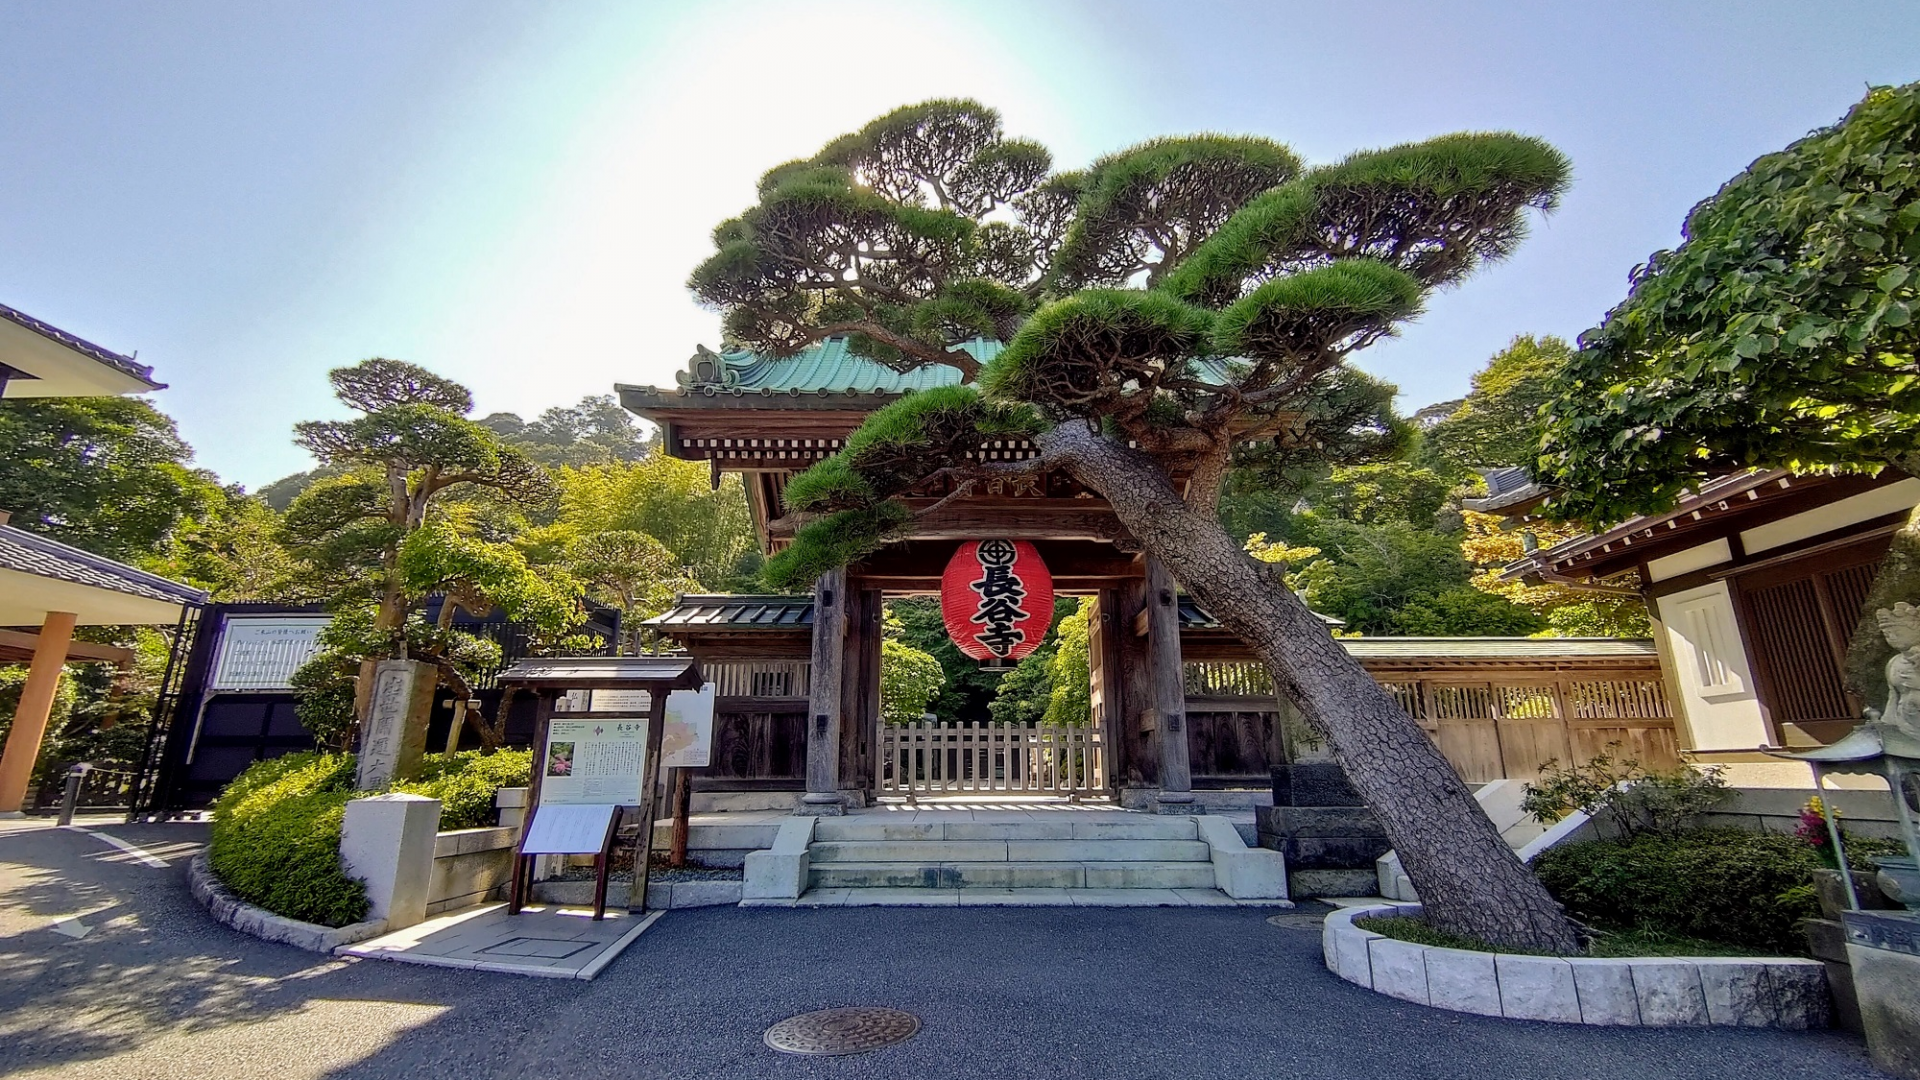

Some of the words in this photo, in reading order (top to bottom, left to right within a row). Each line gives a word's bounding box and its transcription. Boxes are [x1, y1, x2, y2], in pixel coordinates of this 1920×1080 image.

[970, 564, 1031, 658] 長谷寺
[616, 723, 641, 732] 長谷寺
